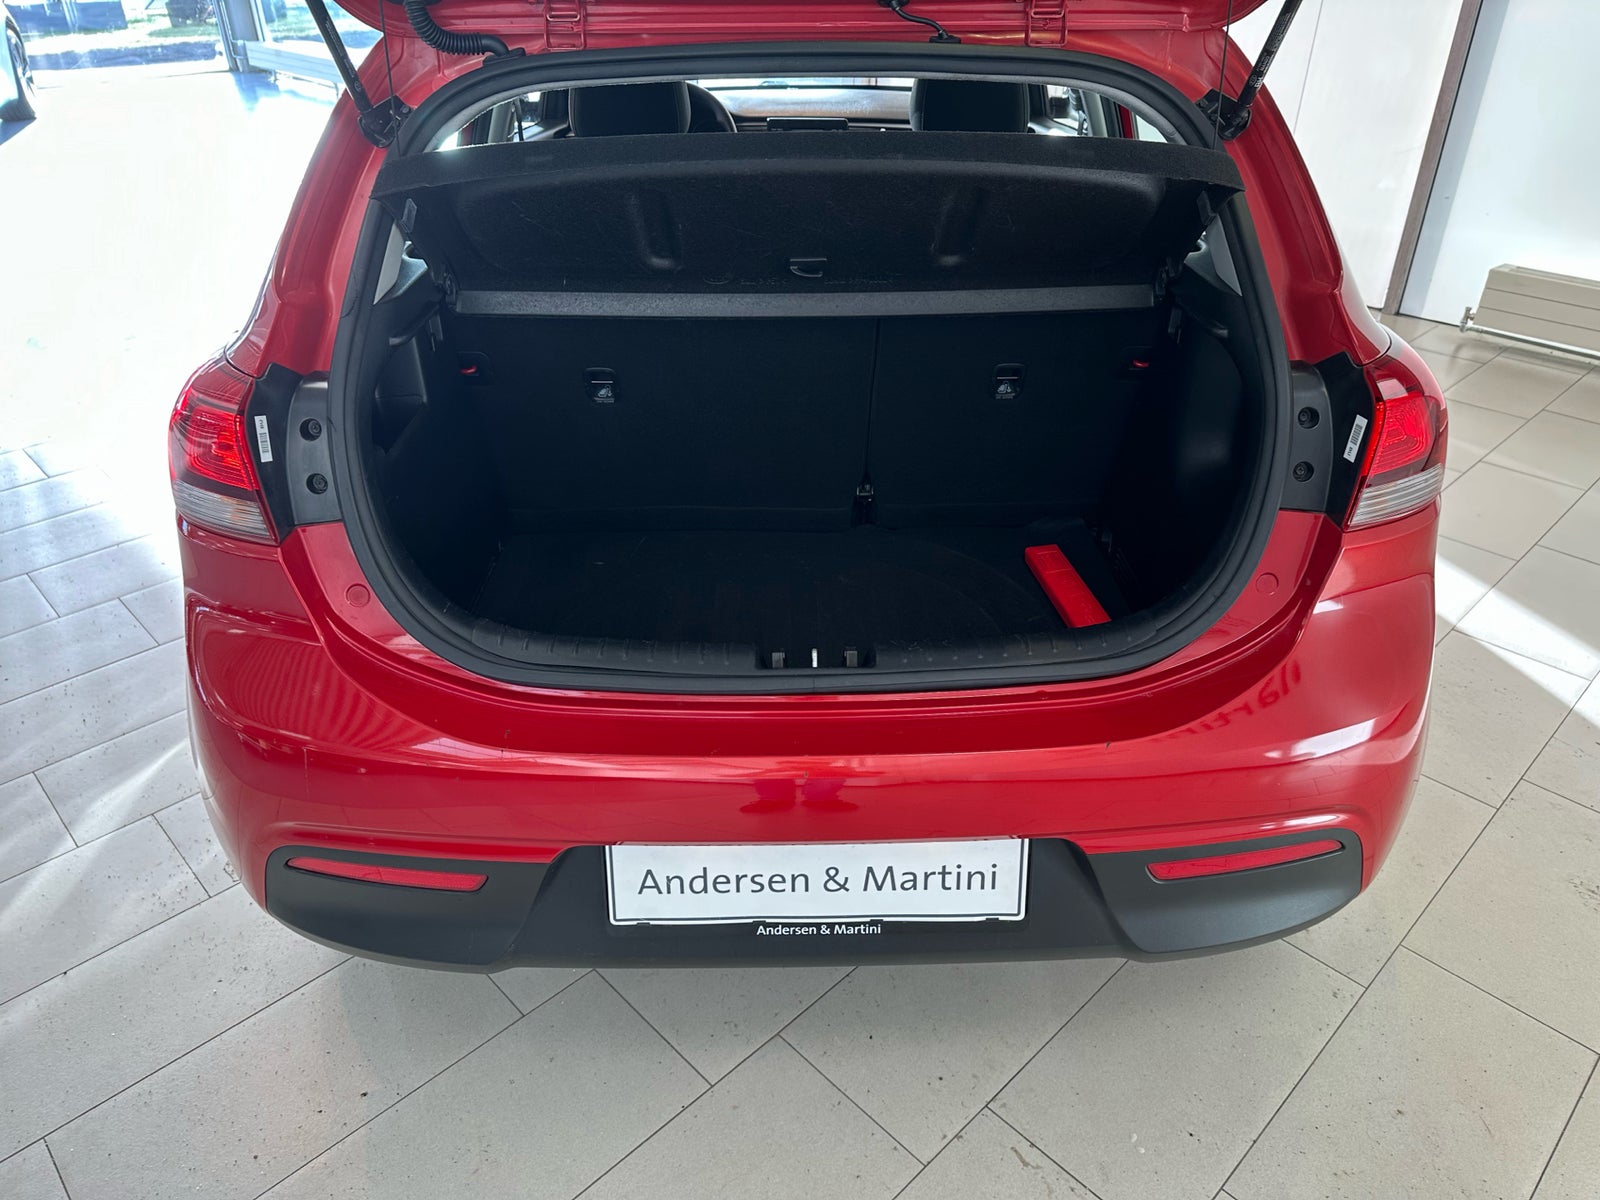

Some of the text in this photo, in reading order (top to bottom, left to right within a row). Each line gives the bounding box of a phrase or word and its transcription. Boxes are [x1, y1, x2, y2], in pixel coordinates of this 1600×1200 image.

[638, 863, 998, 895] Andersen & Martini
[756, 923, 882, 936] Andersen & Martini
